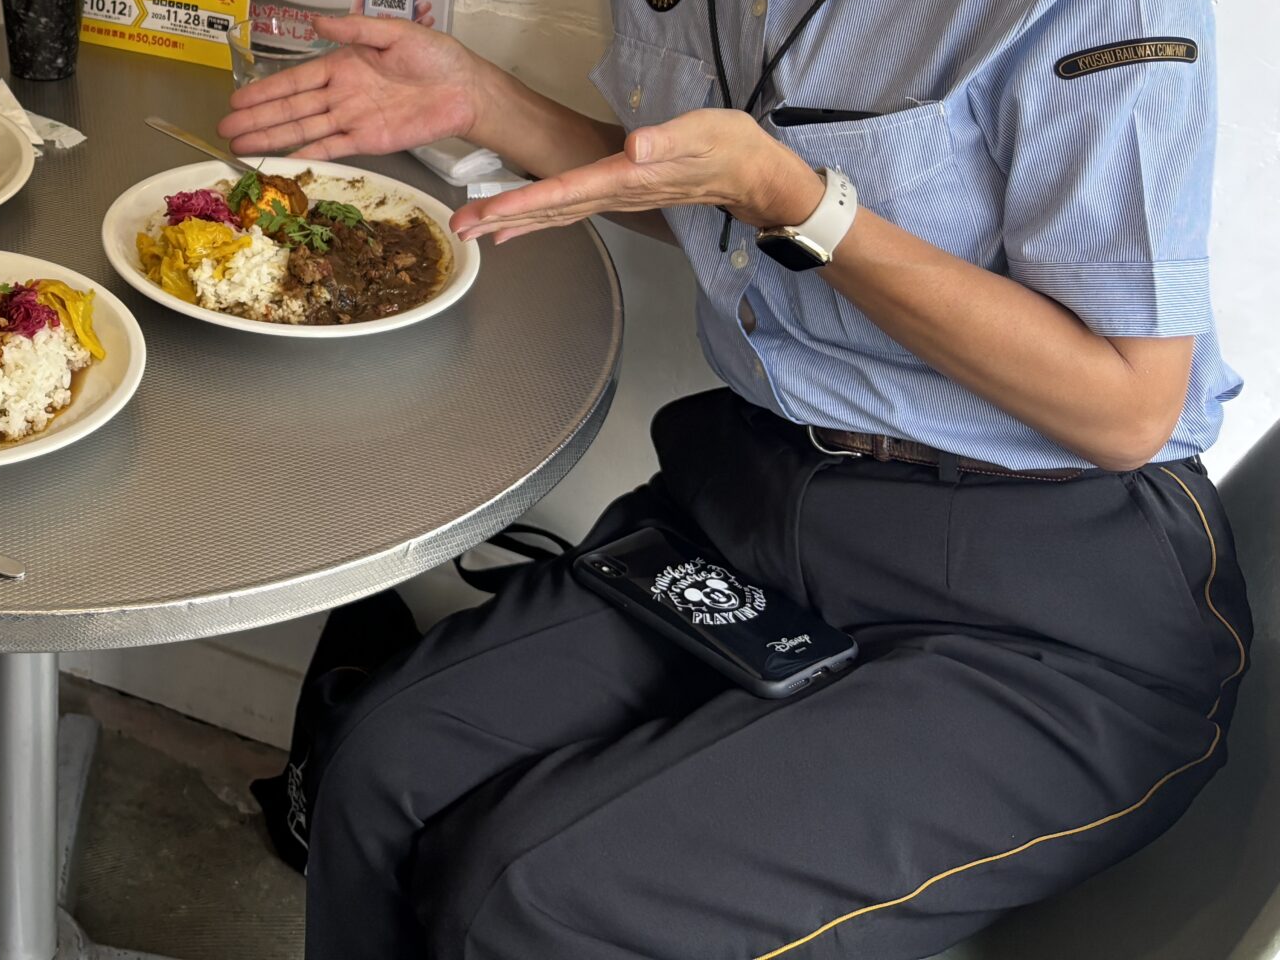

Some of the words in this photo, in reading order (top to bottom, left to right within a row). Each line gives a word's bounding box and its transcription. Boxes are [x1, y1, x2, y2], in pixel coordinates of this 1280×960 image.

[151, 12, 166, 20] 2026
[166, 9, 200, 27] 11.28
[1077, 51, 1115, 70] KYUSHU
[1116, 44, 1156, 62] RAILWAY
[1157, 44, 1187, 57] COMPANY
